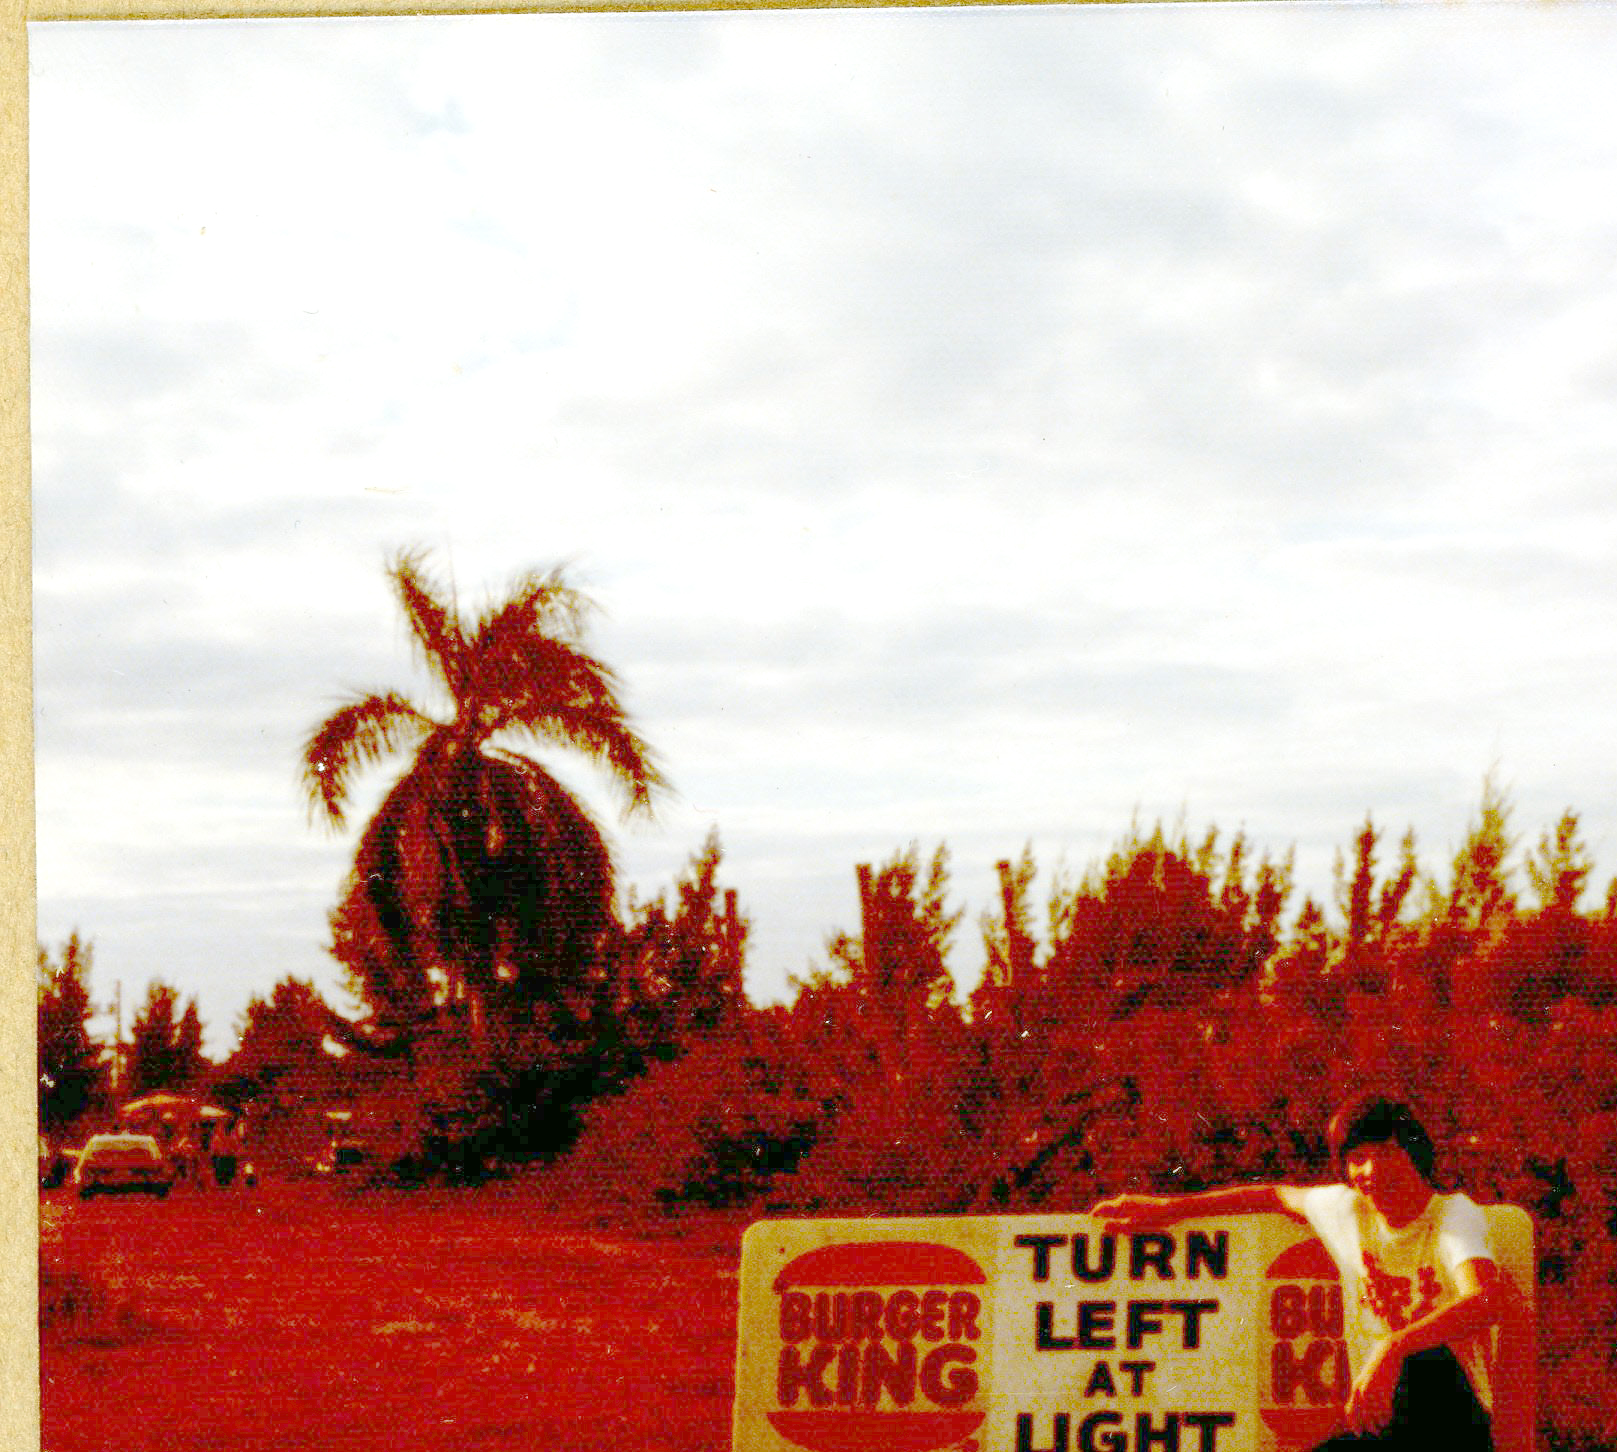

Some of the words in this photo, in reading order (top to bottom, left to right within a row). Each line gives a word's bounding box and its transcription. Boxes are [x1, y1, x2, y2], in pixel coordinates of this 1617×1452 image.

[1014, 1231, 1229, 1284] TURN
[779, 1290, 982, 1343] BURGER
[1036, 1300, 1218, 1351] LEFT
[776, 1343, 980, 1408] KING
[1085, 1361, 1154, 1398] AT
